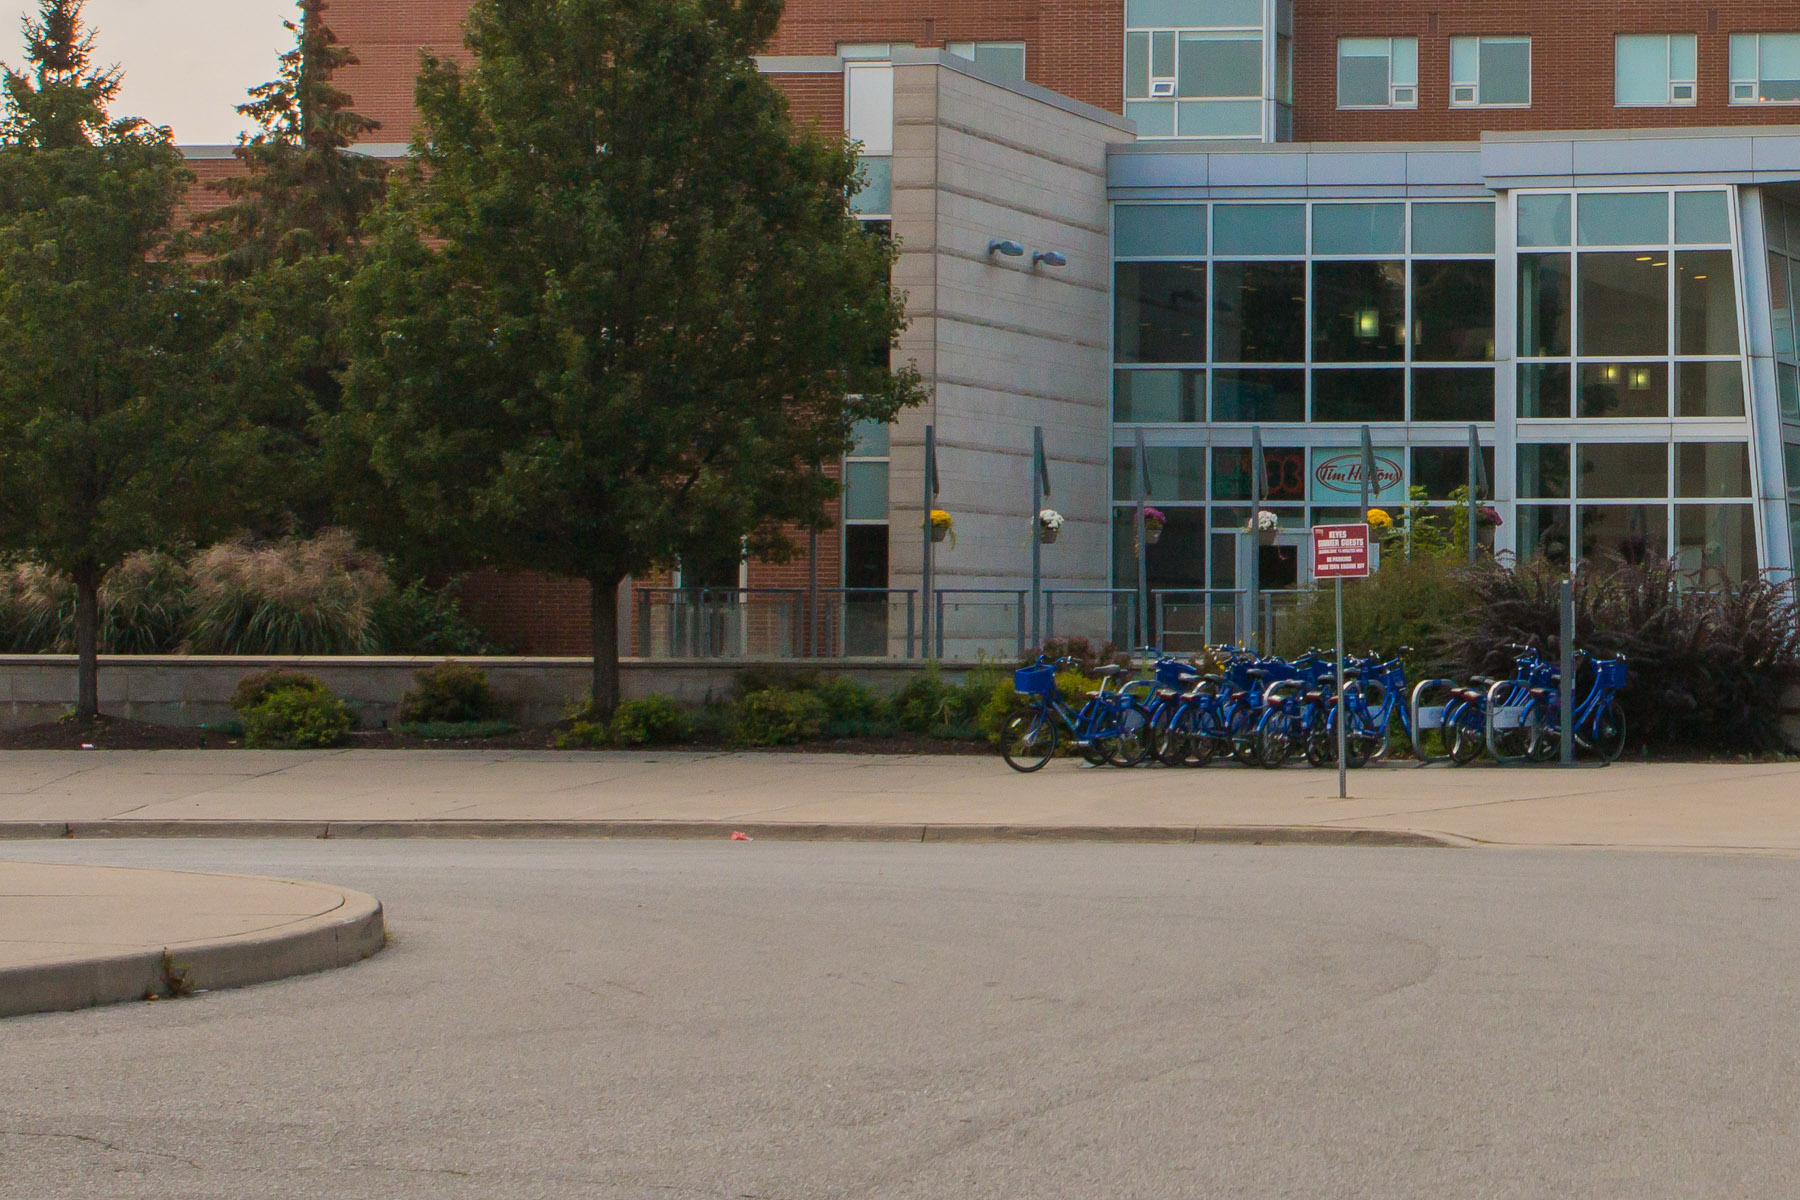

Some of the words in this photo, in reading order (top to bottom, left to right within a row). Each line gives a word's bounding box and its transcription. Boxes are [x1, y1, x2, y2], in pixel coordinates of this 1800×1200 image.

[1320, 465, 1345, 481] Tim
[1348, 464, 1402, 481] Htons
[1328, 530, 1346, 538] KEYES
[1341, 538, 1364, 546] GUESTS
